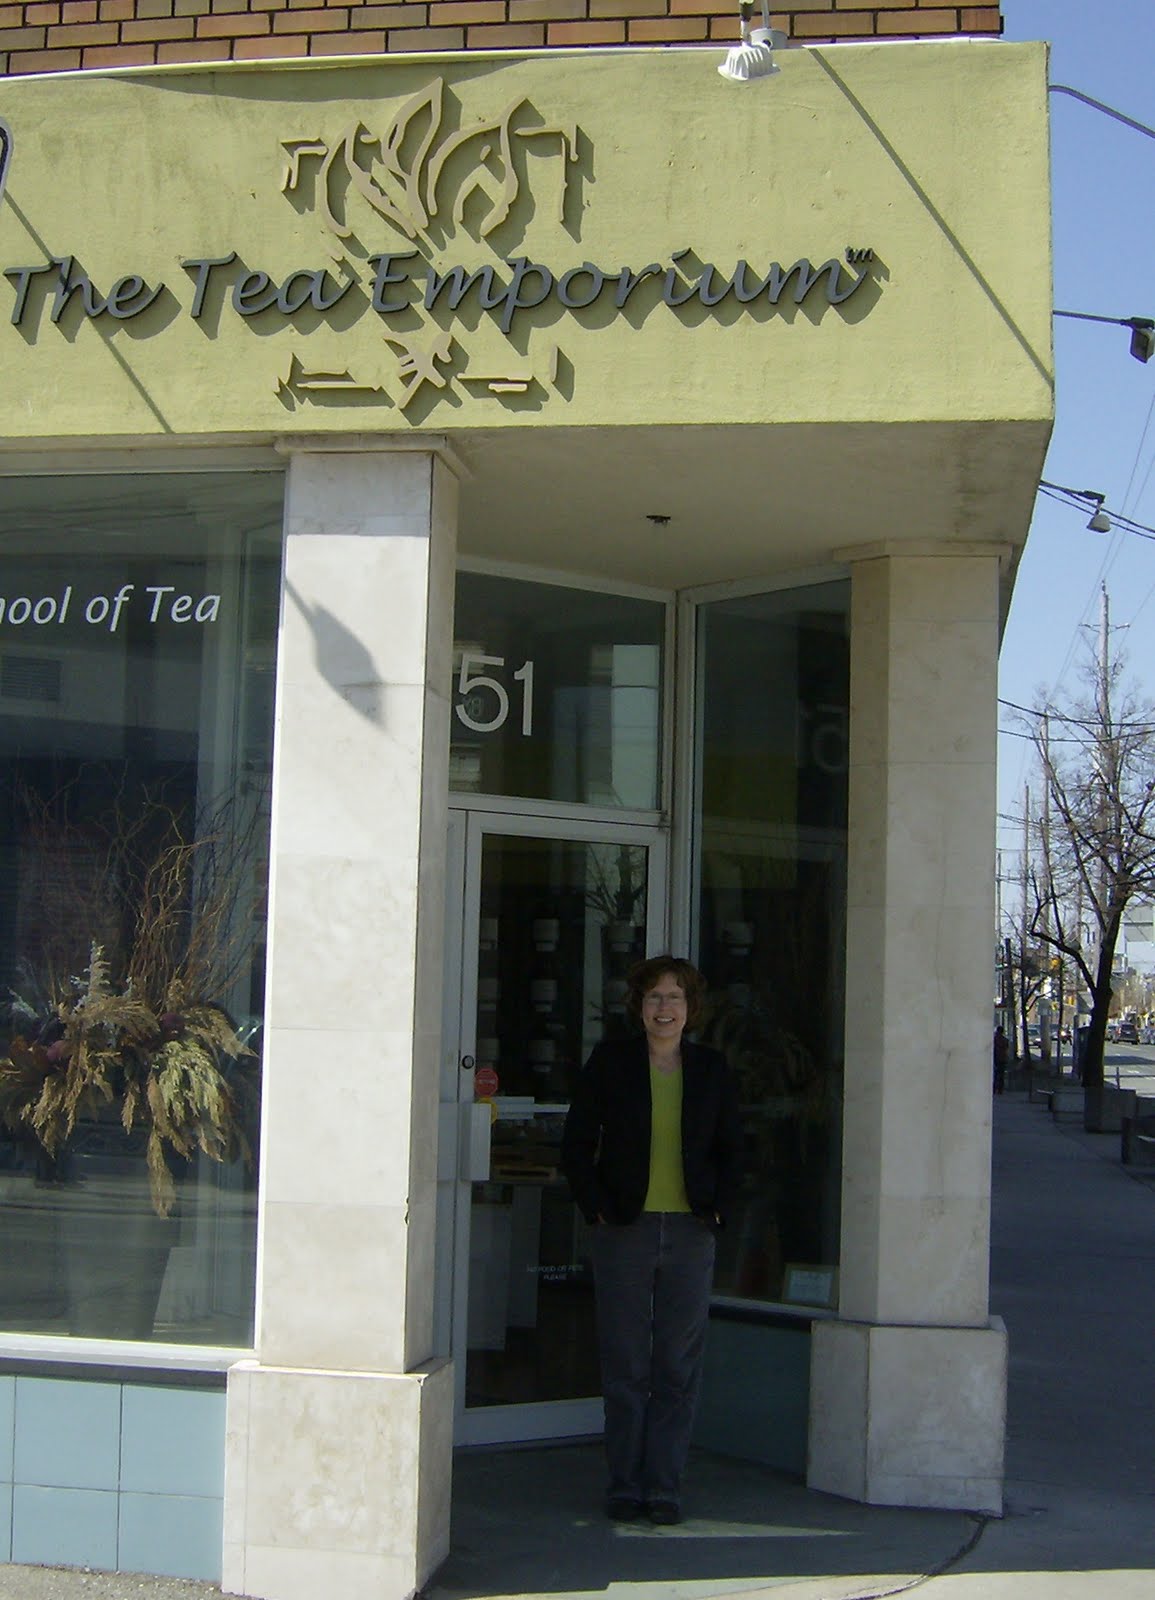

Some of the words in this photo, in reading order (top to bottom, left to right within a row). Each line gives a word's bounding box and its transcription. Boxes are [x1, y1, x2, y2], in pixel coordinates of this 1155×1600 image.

[2, 254, 167, 326] The
[181, 250, 355, 319] Tea
[366, 247, 868, 334] Emporium
[85, 584, 135, 633] of
[145, 586, 221, 623] Tea
[455, 652, 534, 737] 51
